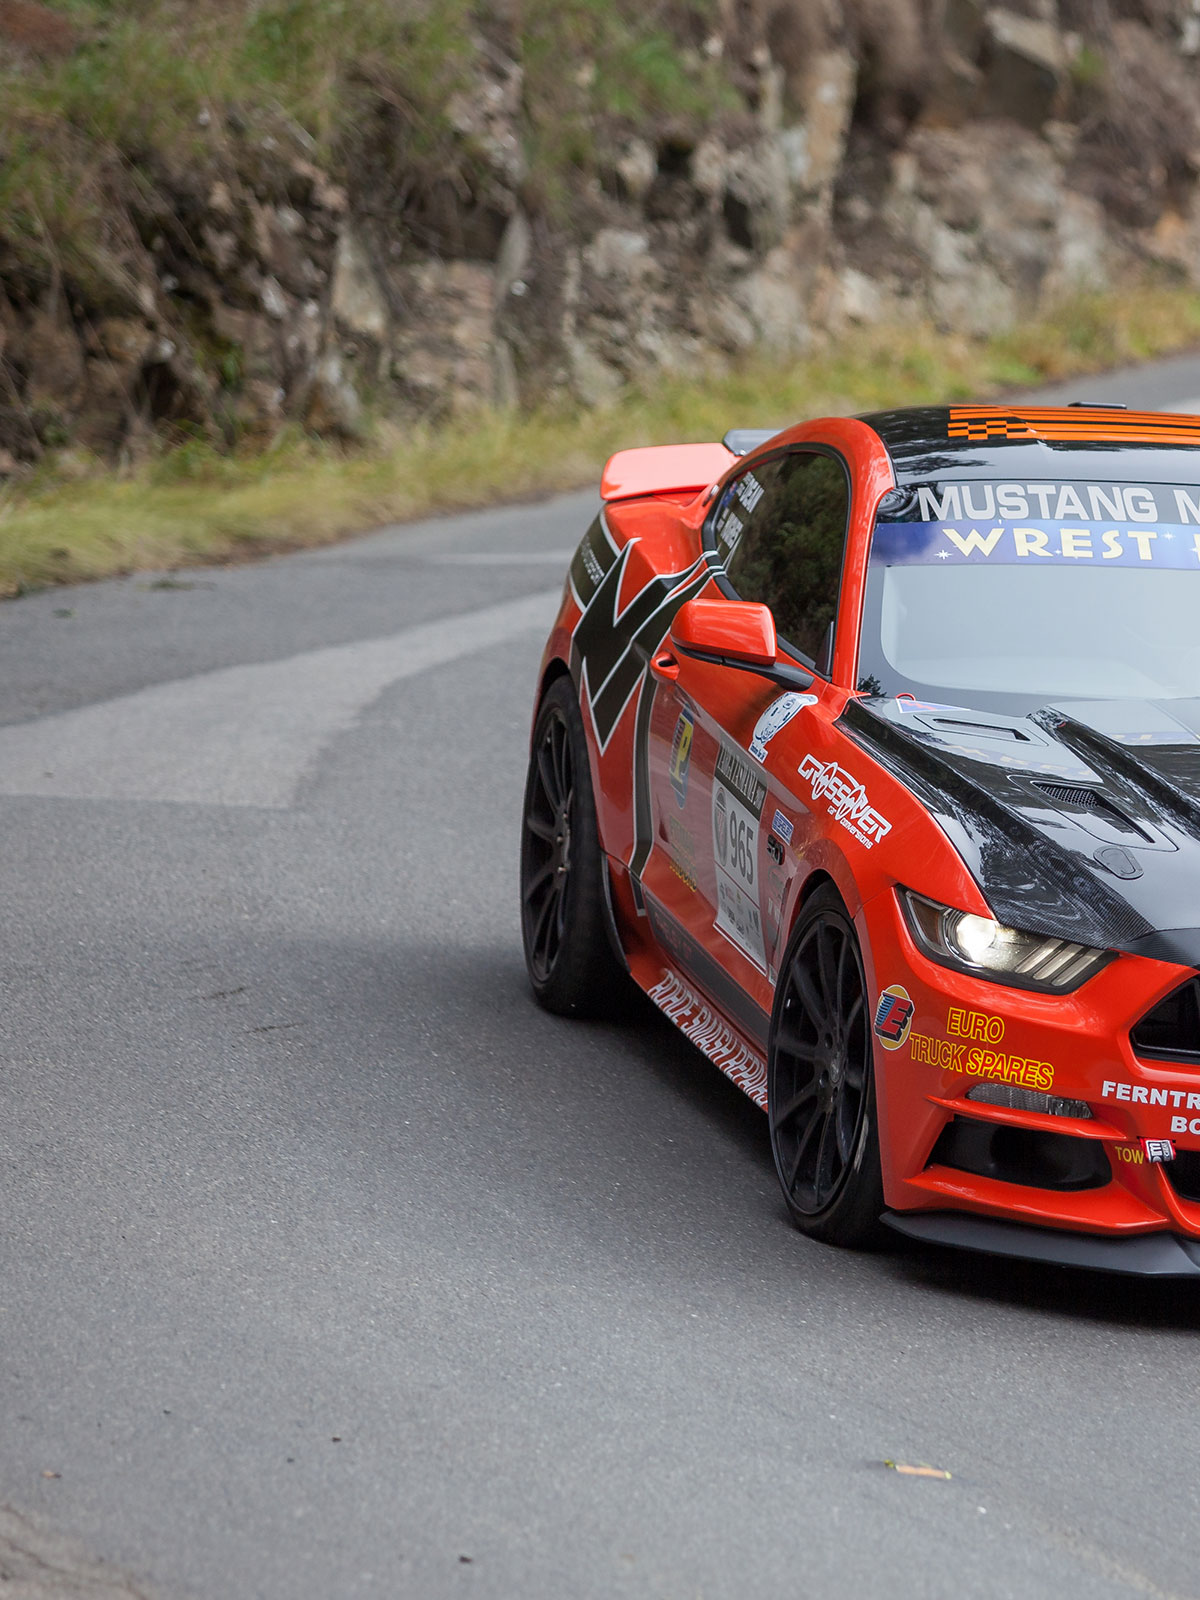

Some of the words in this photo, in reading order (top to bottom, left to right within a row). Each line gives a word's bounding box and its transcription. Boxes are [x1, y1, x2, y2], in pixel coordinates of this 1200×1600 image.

[917, 484, 1159, 522] MUSTANG
[942, 528, 1158, 560] WREST
[797, 753, 893, 844] CROSSOVER
[729, 810, 754, 885] 965
[681, 1005, 741, 1070] SMASH
[947, 1007, 1005, 1044] EURO
[909, 1032, 967, 1073] TRUCK
[965, 1047, 1055, 1090] SPARES
[1114, 1146, 1145, 1165] TOW
